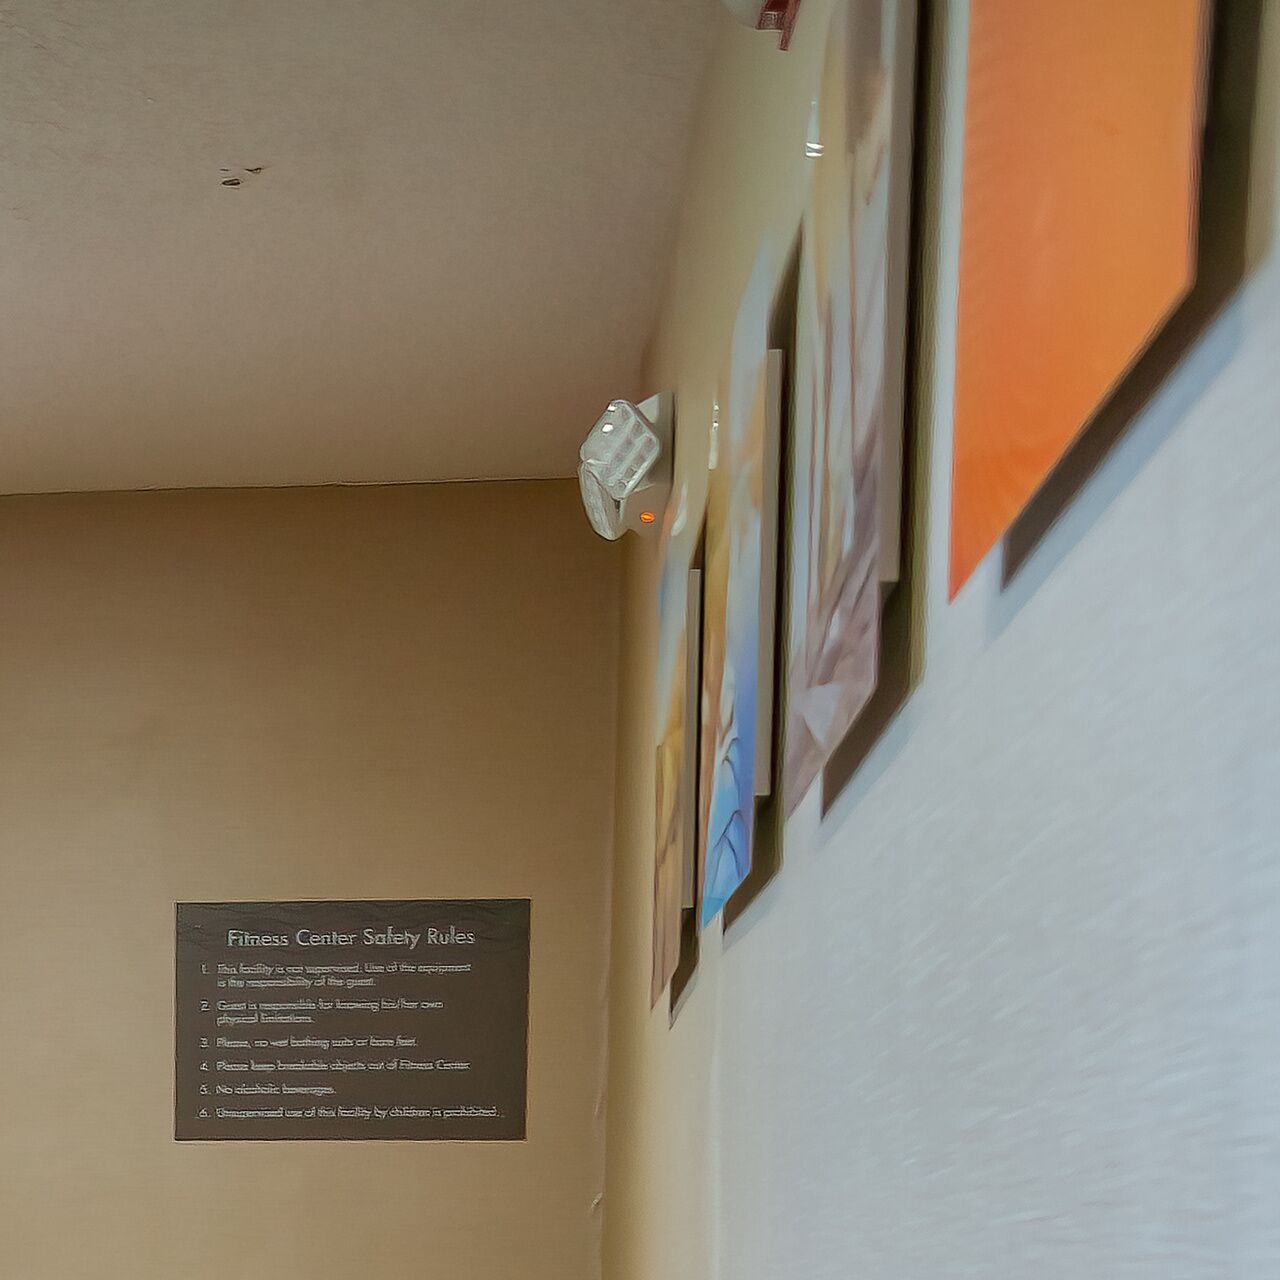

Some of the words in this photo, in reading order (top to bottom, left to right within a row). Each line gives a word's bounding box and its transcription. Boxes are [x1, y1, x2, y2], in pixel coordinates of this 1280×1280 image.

[227, 929, 289, 947] Fitness
[295, 929, 357, 946] Center
[362, 926, 421, 950] Safety
[426, 926, 476, 945] Rules
